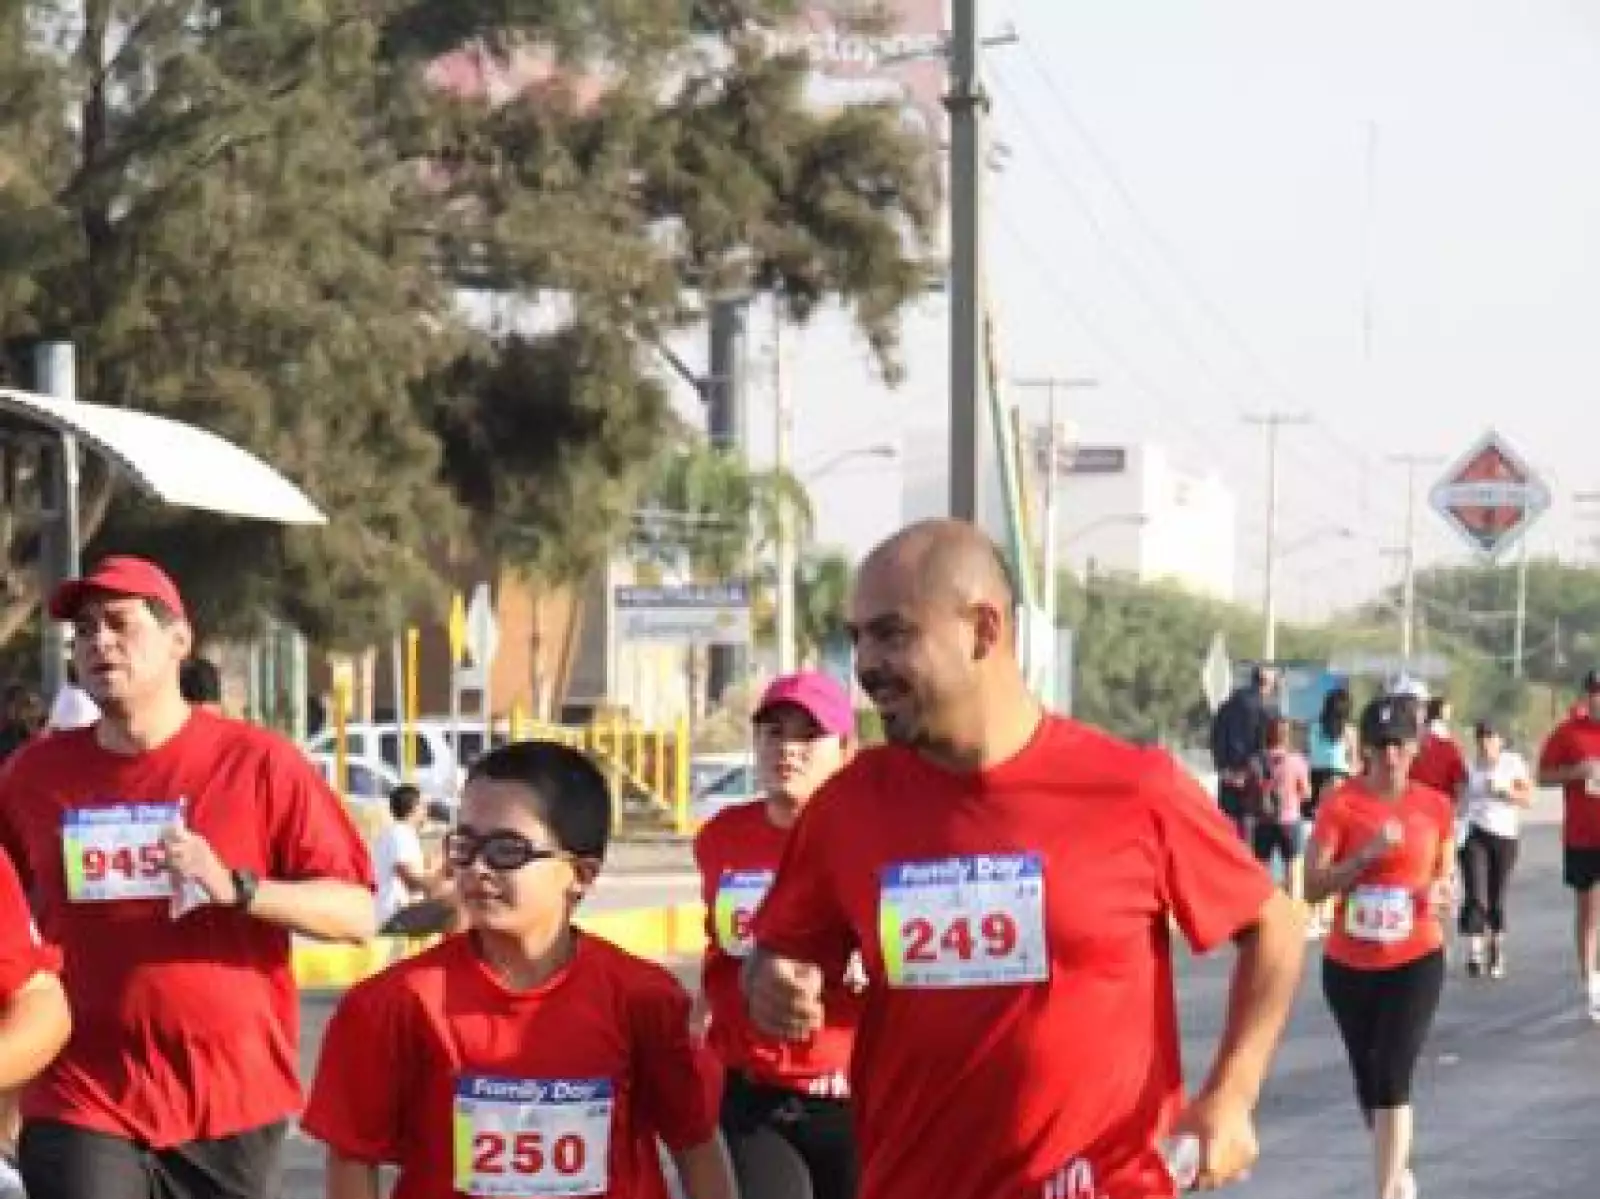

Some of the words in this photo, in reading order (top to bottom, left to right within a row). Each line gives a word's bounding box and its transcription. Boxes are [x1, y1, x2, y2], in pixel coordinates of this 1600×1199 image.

[82, 839, 168, 880] 945
[902, 859, 972, 888] Family
[977, 856, 1024, 885] Day
[902, 912, 1018, 962] 249
[472, 1078, 547, 1104] Family
[551, 1081, 597, 1105] Day
[472, 1130, 586, 1176] 250
